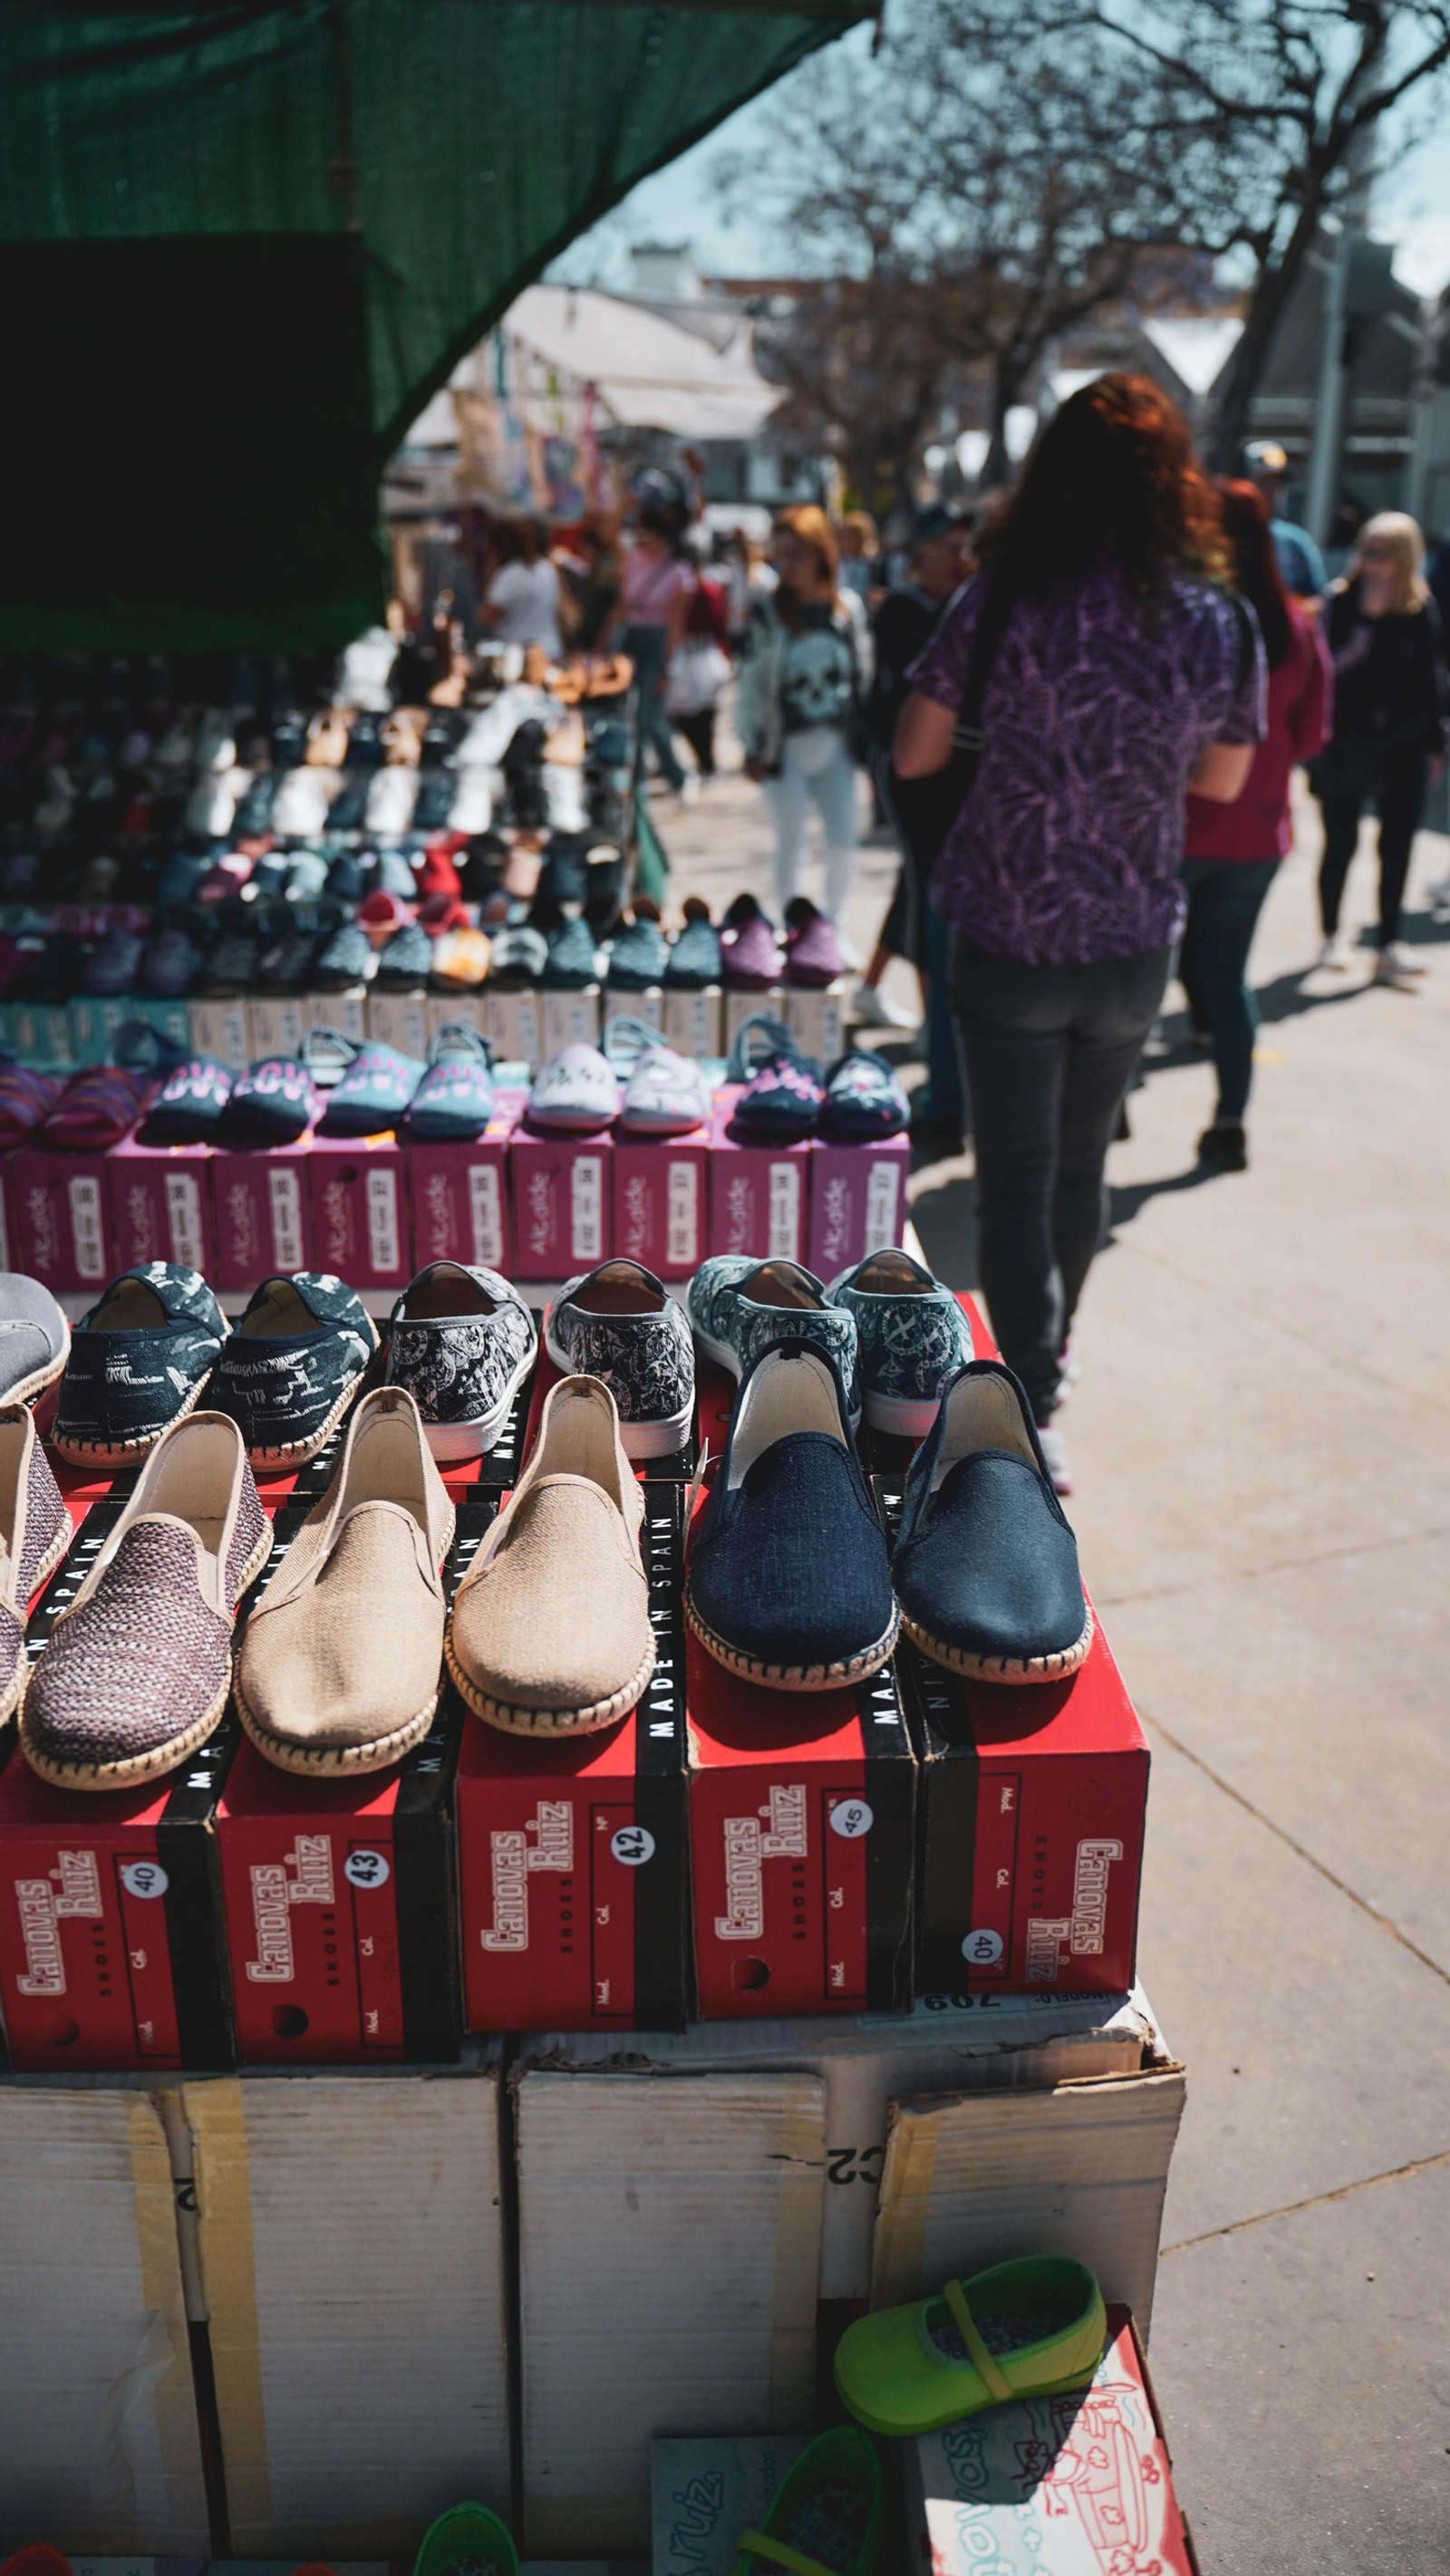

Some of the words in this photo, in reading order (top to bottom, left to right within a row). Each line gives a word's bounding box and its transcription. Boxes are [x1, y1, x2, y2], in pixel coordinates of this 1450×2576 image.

[652, 1517, 672, 1587] SPAIN
[651, 1609, 672, 1636] IN
[650, 1658, 674, 1738] MADE
[525, 1801, 574, 1871] Ruiz
[616, 1830, 645, 1858] 42
[758, 1784, 807, 1857] Ruiz
[845, 1809, 863, 1834] 45
[48, 1850, 103, 1918] Ruiz
[134, 1867, 155, 1892] 40
[284, 1835, 334, 1905] Ruiz
[351, 1854, 380, 1882] 43
[480, 1831, 528, 1952] Canovas
[714, 1817, 763, 1940] Canovas
[792, 1864, 806, 1940] SHOES
[1031, 1836, 1047, 1910] SHOES
[1070, 1838, 1124, 1954] Canovas
[14, 1879, 66, 1996] Canovas
[245, 1865, 295, 1983] Canovas
[323, 1912, 340, 1987] SHOES
[560, 1878, 573, 1954] SHOES
[974, 1936, 993, 1959] 40
[1026, 1917, 1073, 1983] Ruiz
[92, 1924, 112, 1996] SHOES
